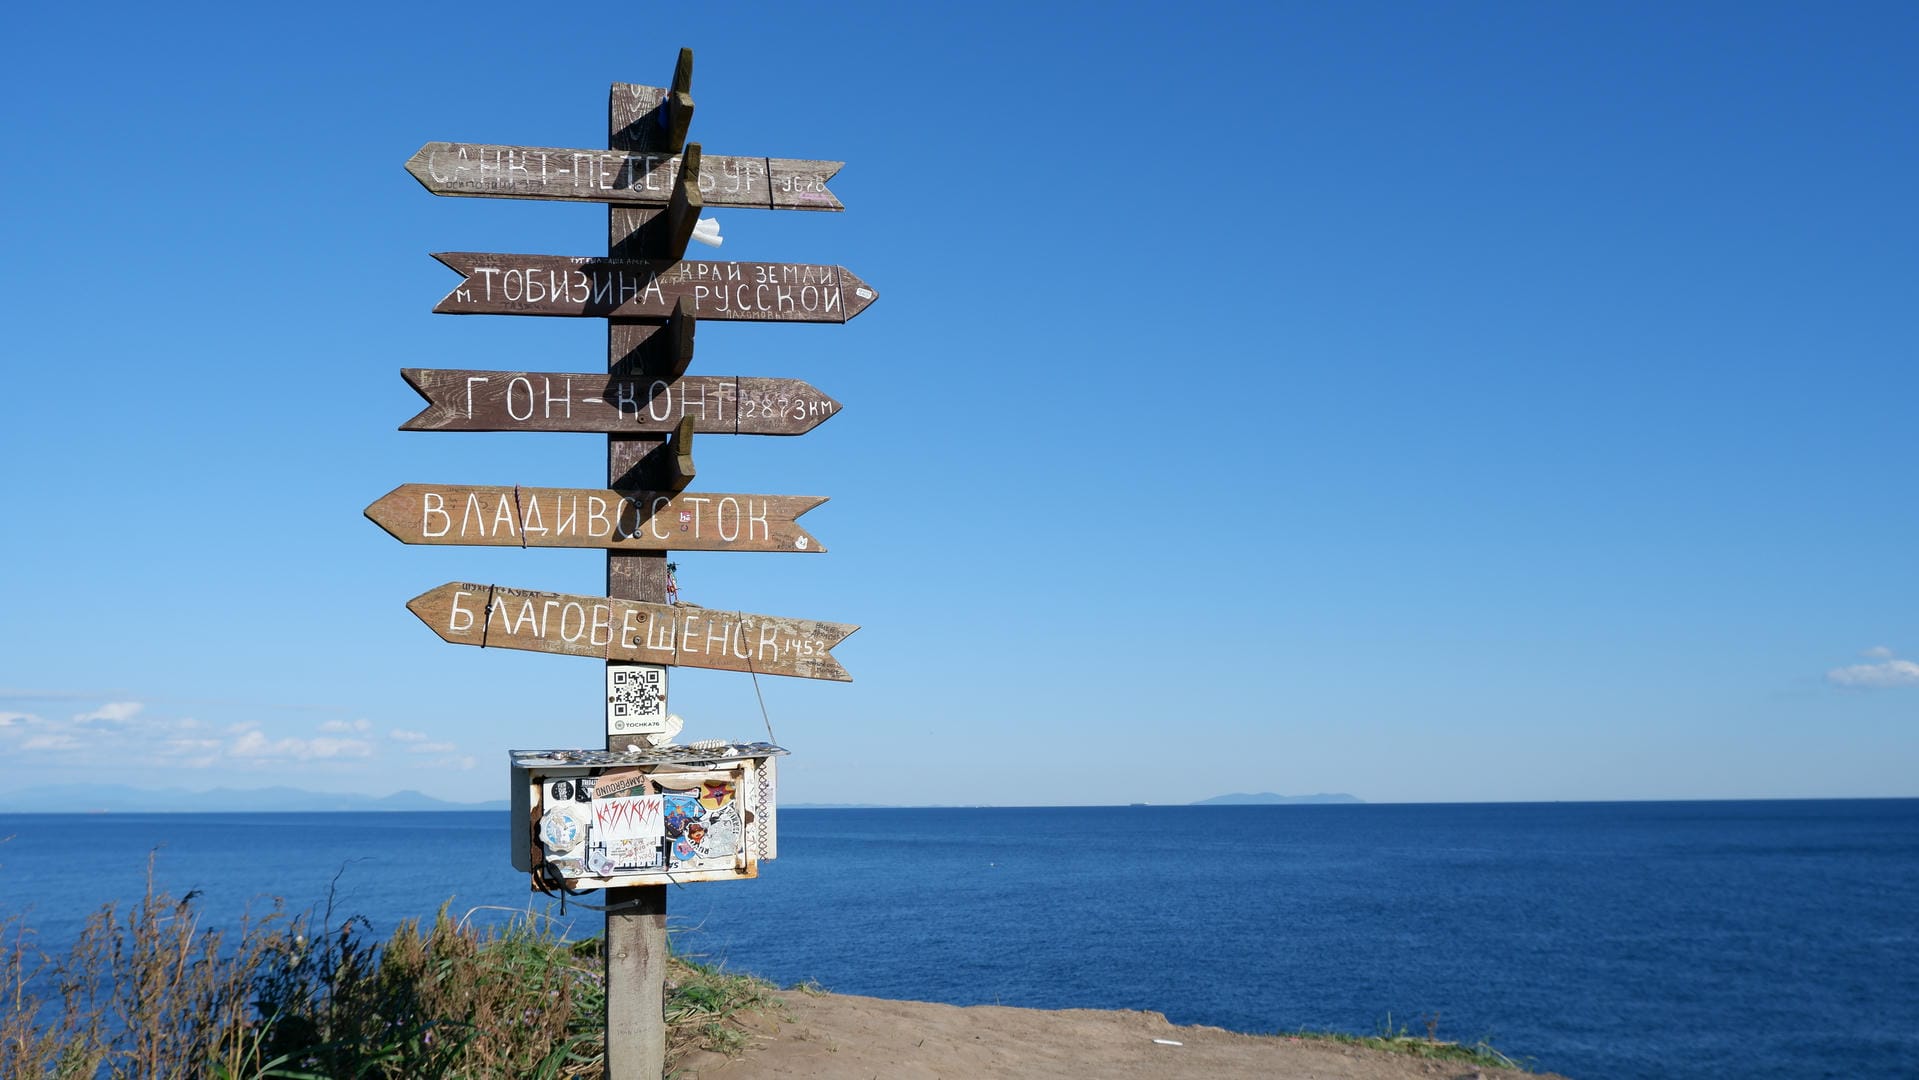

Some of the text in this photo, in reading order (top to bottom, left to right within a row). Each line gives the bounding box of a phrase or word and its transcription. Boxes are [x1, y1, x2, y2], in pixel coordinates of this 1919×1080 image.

[474, 267, 665, 305] ТОБИЗИНА
[680, 261, 741, 281] КРАЙ
[756, 265, 833, 285] ЗЕМЛИ
[695, 283, 841, 313] РУССКОЙ
[422, 492, 769, 542] ВЛАДИВОСТОК
[449, 591, 779, 662] БЛАГОВЕЩЕНСК
[785, 638, 826, 657] 1452
[595, 774, 646, 797] CAMPGROUND
